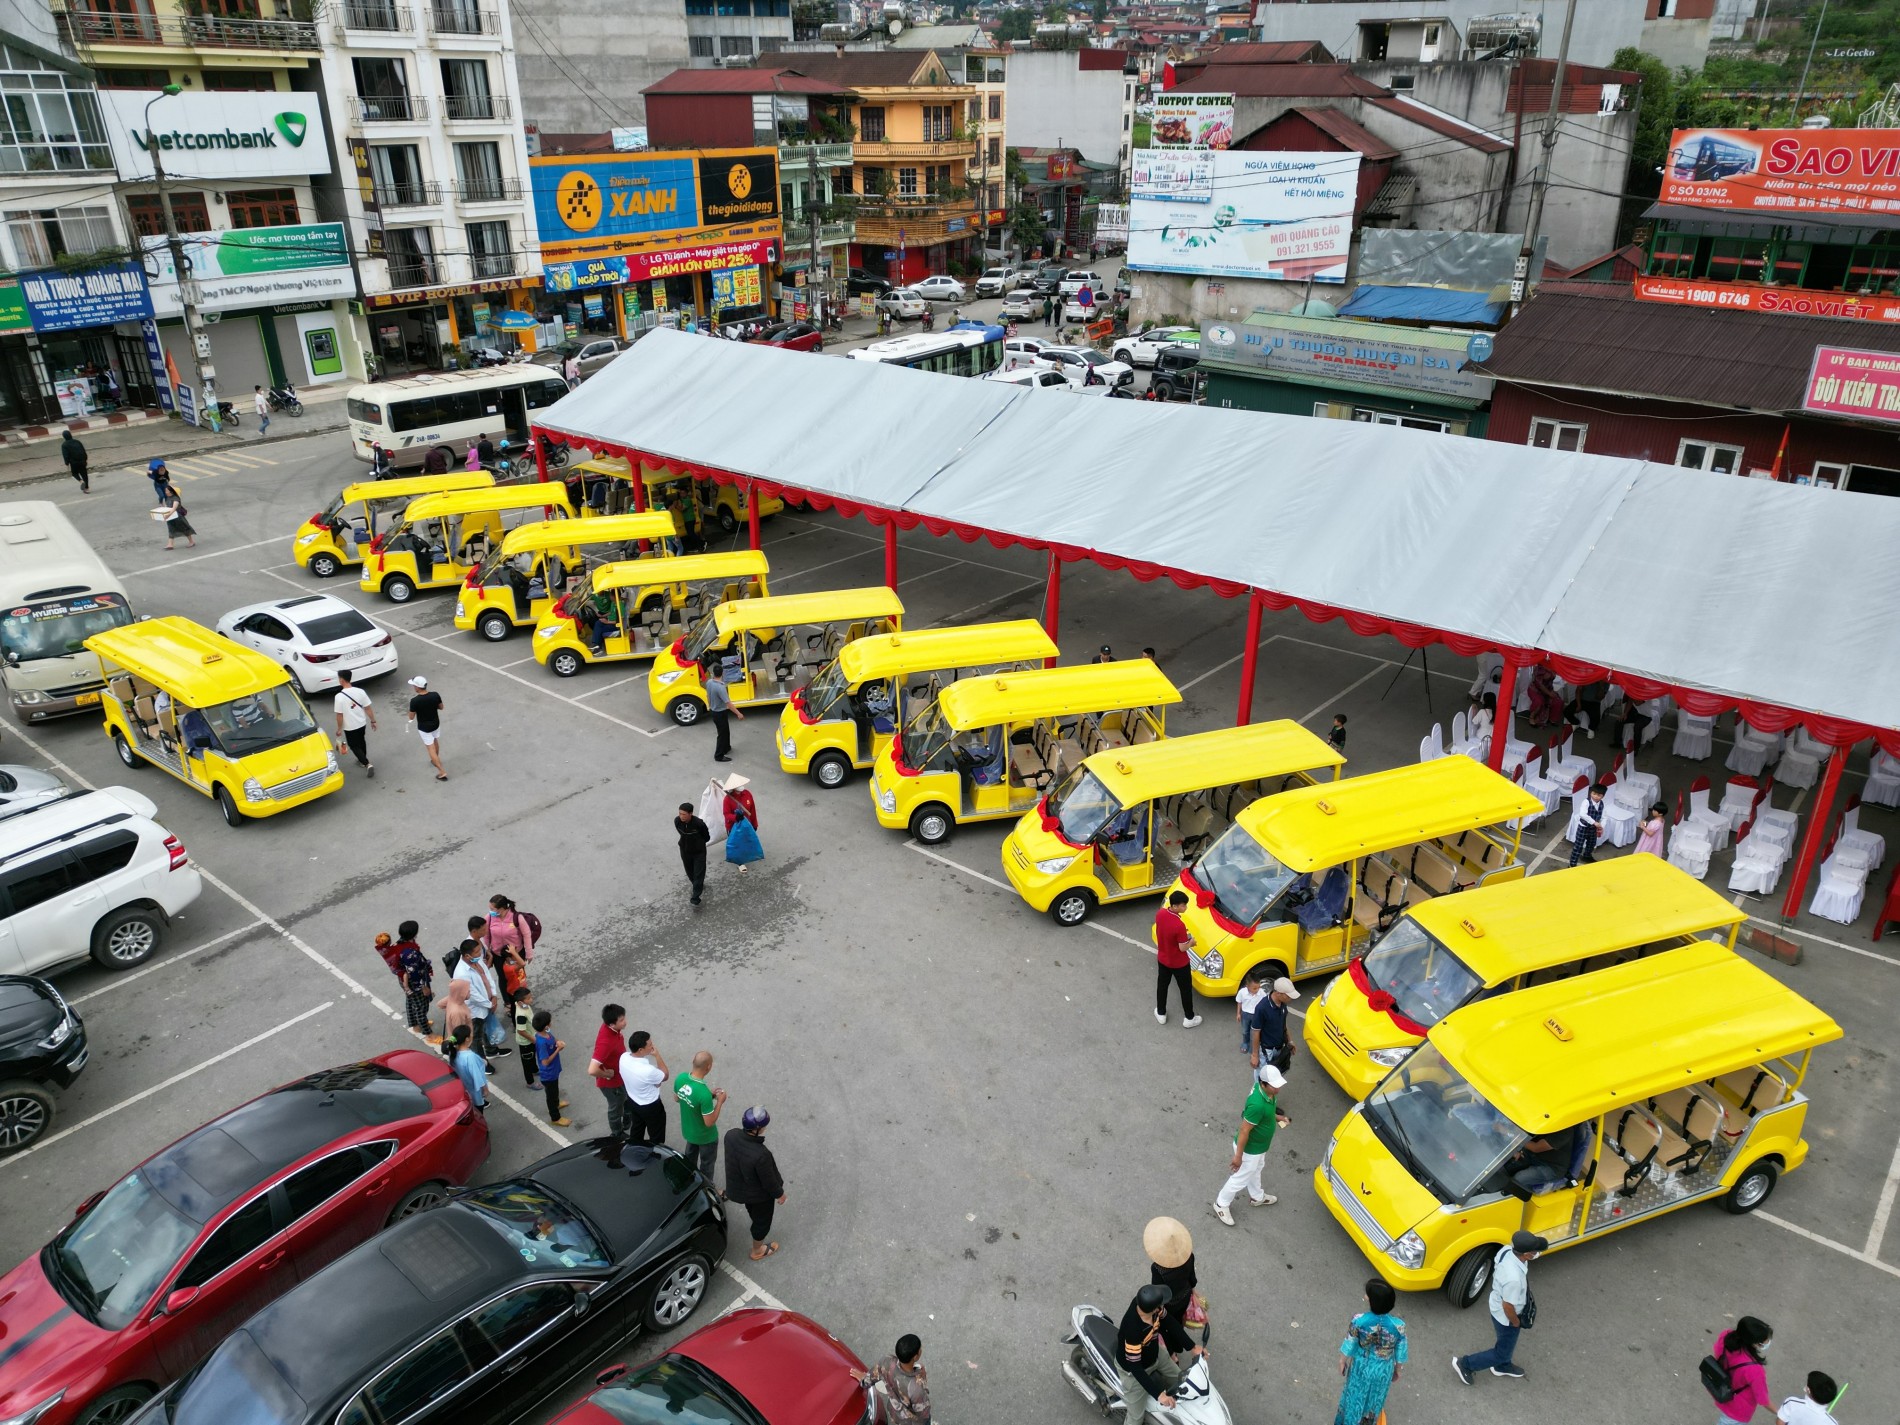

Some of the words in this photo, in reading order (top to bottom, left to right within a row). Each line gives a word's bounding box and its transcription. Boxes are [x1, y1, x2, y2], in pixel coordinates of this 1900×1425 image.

[1846, 48, 1875, 57] Gecko
[1158, 96, 1194, 106] HOTPOT
[1196, 96, 1233, 106] CENTER
[132, 128, 277, 151] Vietcombank
[1766, 138, 1854, 176] SAO
[1860, 148, 1900, 177] VI
[1697, 187, 1728, 197] 03/N2
[610, 188, 678, 217] XANH
[708, 200, 773, 218] thegioididong
[758, 224, 778, 233] SONY
[283, 234, 306, 242] trong
[325, 232, 338, 240] tay
[650, 255, 662, 264] LG
[727, 252, 754, 268] 25%
[24, 276, 51, 303] NHÀ
[84, 271, 122, 296] HOÀNG
[120, 272, 143, 292] MAI
[219, 285, 245, 296] TMCP
[394, 292, 422, 303] VIP
[425, 286, 475, 300] HOTEL
[480, 282, 498, 293] SA
[500, 280, 519, 291] PA
[1687, 289, 1716, 303] 1900
[1719, 292, 1750, 306] 6746
[1760, 292, 1812, 313] SAO
[274, 302, 319, 313] Vietcombank
[1290, 339, 1347, 357] THUỐC
[1424, 356, 1449, 370] SA
[1314, 354, 1398, 371] PHARMACY
[1847, 358, 1870, 368] BAN
[1814, 374, 1841, 407] ĐỘI
[1840, 373, 1877, 408] KIỂM
[32, 606, 68, 618] HYUNDAI
